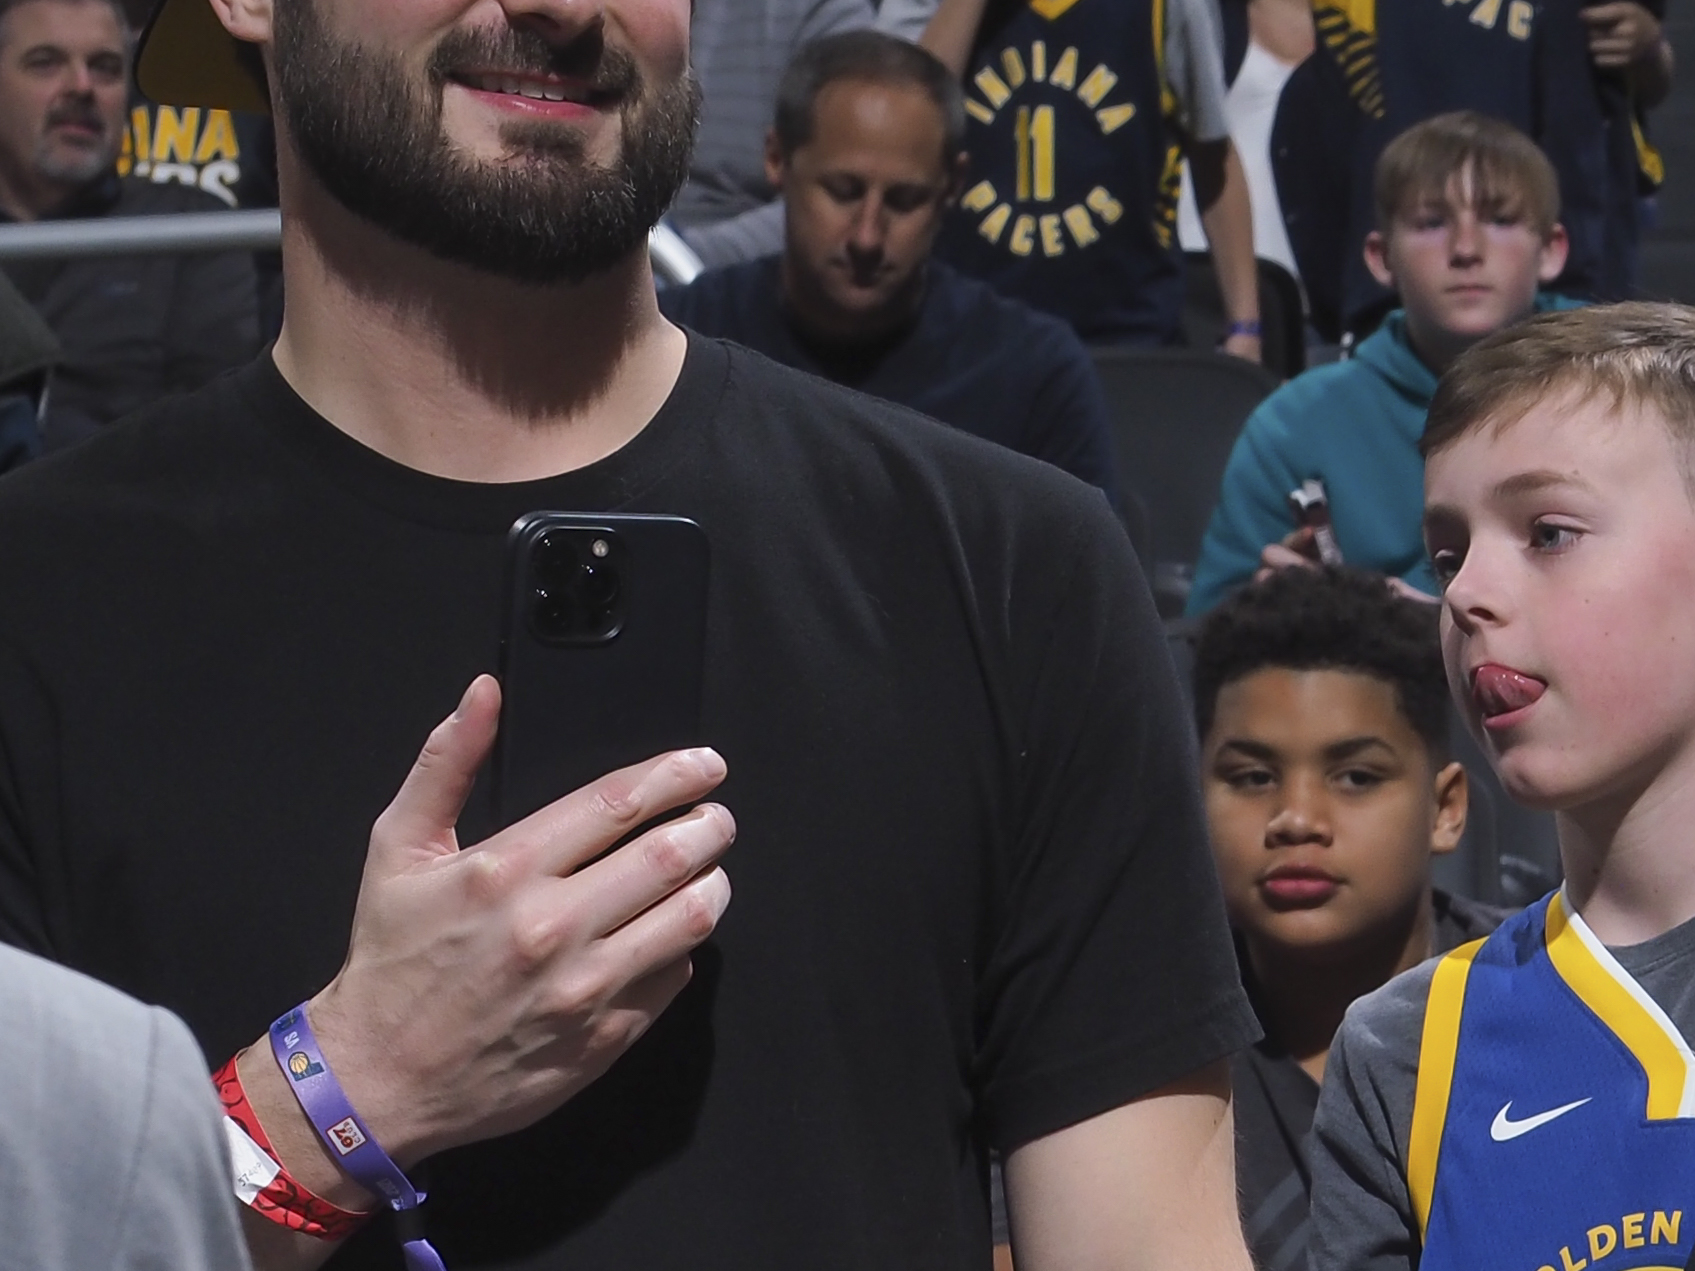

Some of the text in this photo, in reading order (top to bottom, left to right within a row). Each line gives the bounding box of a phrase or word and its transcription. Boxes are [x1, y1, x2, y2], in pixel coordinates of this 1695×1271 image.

[963, 39, 1137, 136] INDIANA
[1014, 103, 1056, 201] 11
[960, 179, 1124, 258] PACERS
